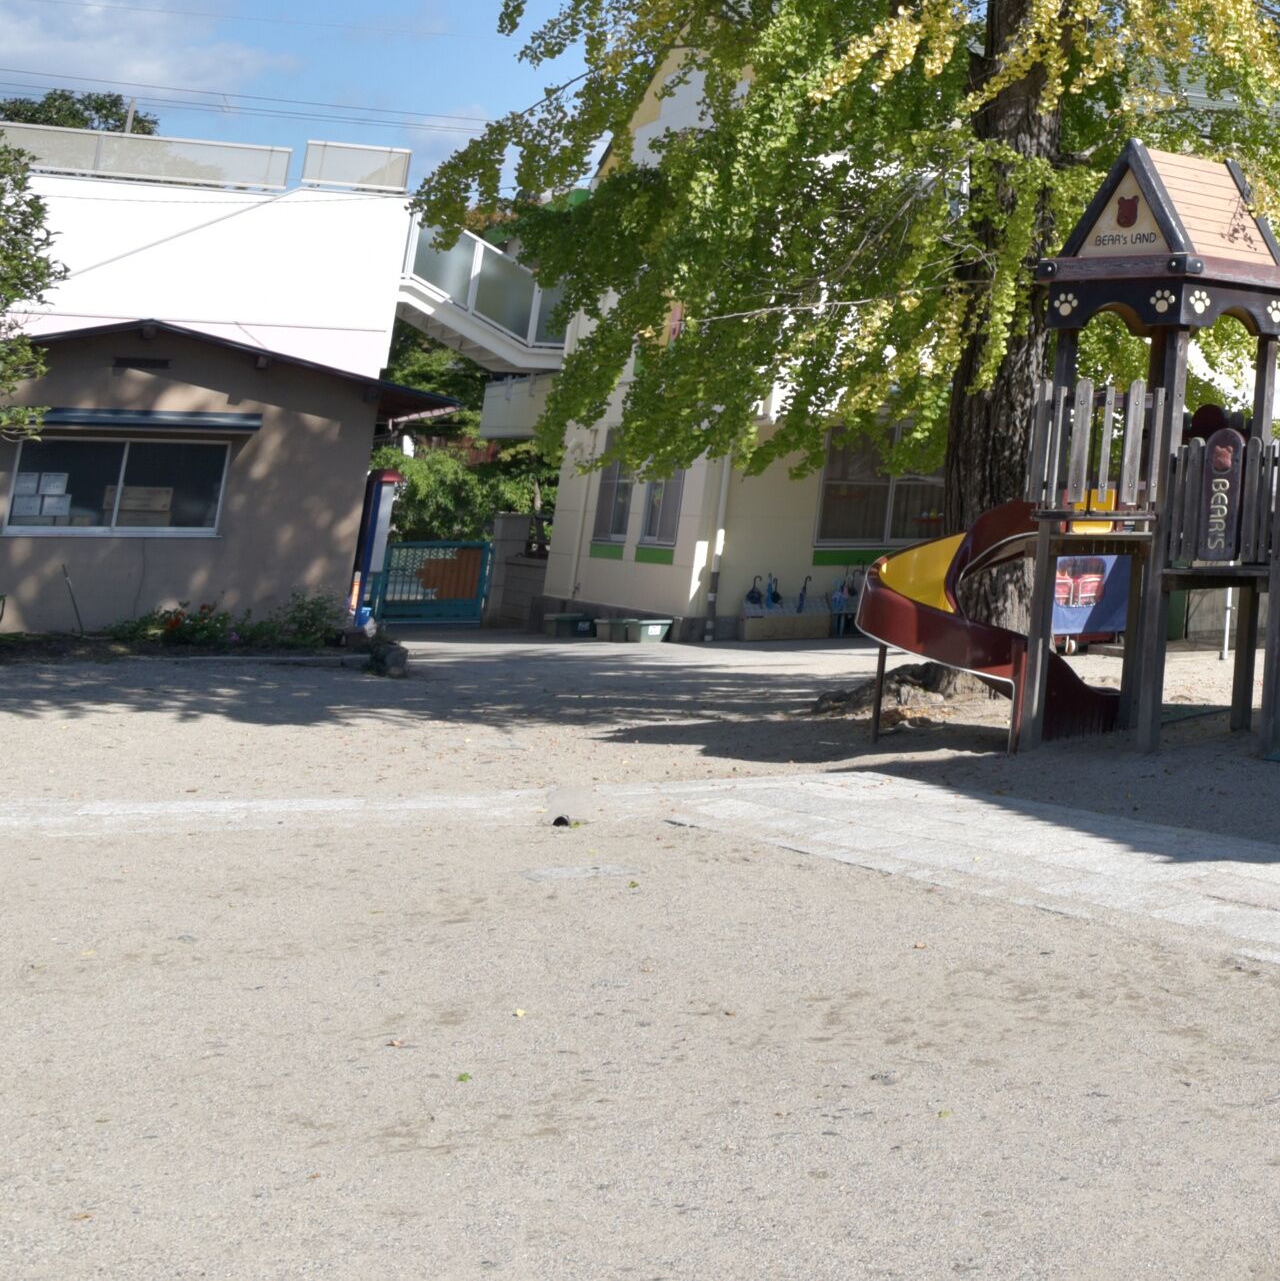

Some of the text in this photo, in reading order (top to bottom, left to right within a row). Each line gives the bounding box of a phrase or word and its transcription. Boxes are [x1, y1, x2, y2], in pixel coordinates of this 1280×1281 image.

[1095, 232, 1157, 246] BEAR's LAND
[1207, 478, 1230, 550] BEAR'S
